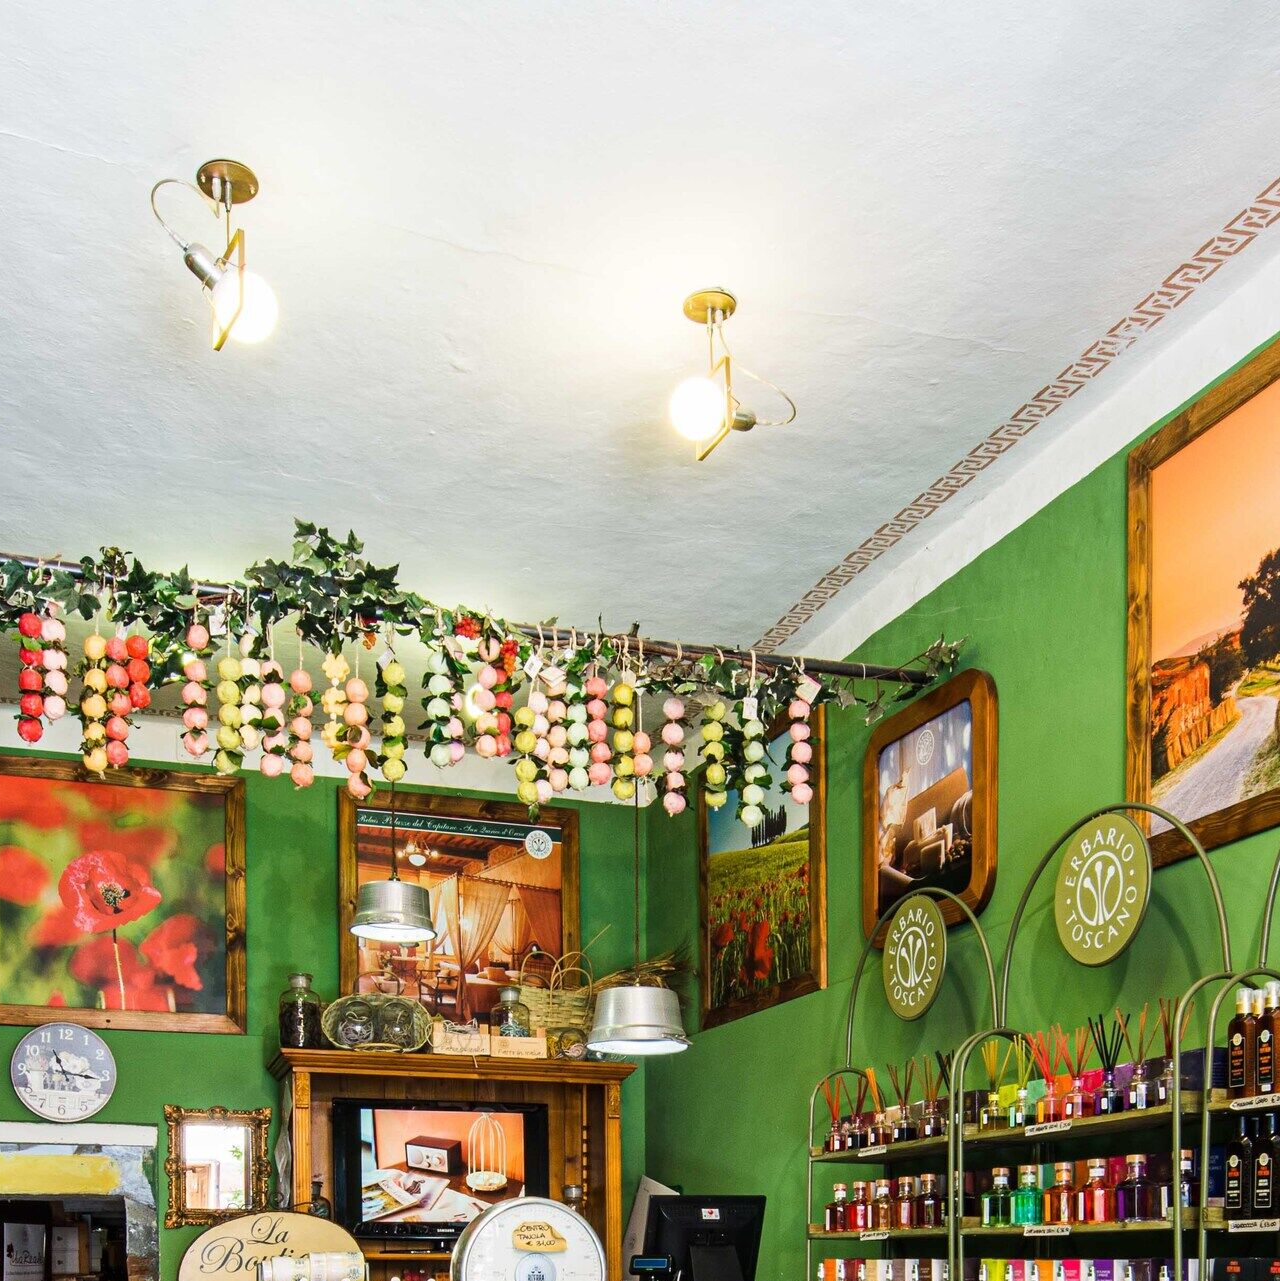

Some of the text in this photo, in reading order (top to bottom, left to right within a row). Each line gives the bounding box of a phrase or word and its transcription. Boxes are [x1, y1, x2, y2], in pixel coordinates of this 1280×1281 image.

[1065, 826, 1135, 888] ERBARIO
[1065, 888, 1138, 951] TOSCANO
[888, 906, 934, 957] ERBARIO
[888, 956, 937, 1007] TOSCANO
[40, 1031, 51, 1043] 11
[59, 1029, 73, 1040] 12
[83, 1034, 89, 1046] 1
[25, 1045, 40, 1056] 10
[96, 1049, 104, 1060] 2
[18, 1062, 26, 1075] 9
[39, 1098, 46, 1108] 7
[80, 1101, 87, 1111] 5
[58, 1104, 65, 1115] 6
[248, 1215, 289, 1245] La
